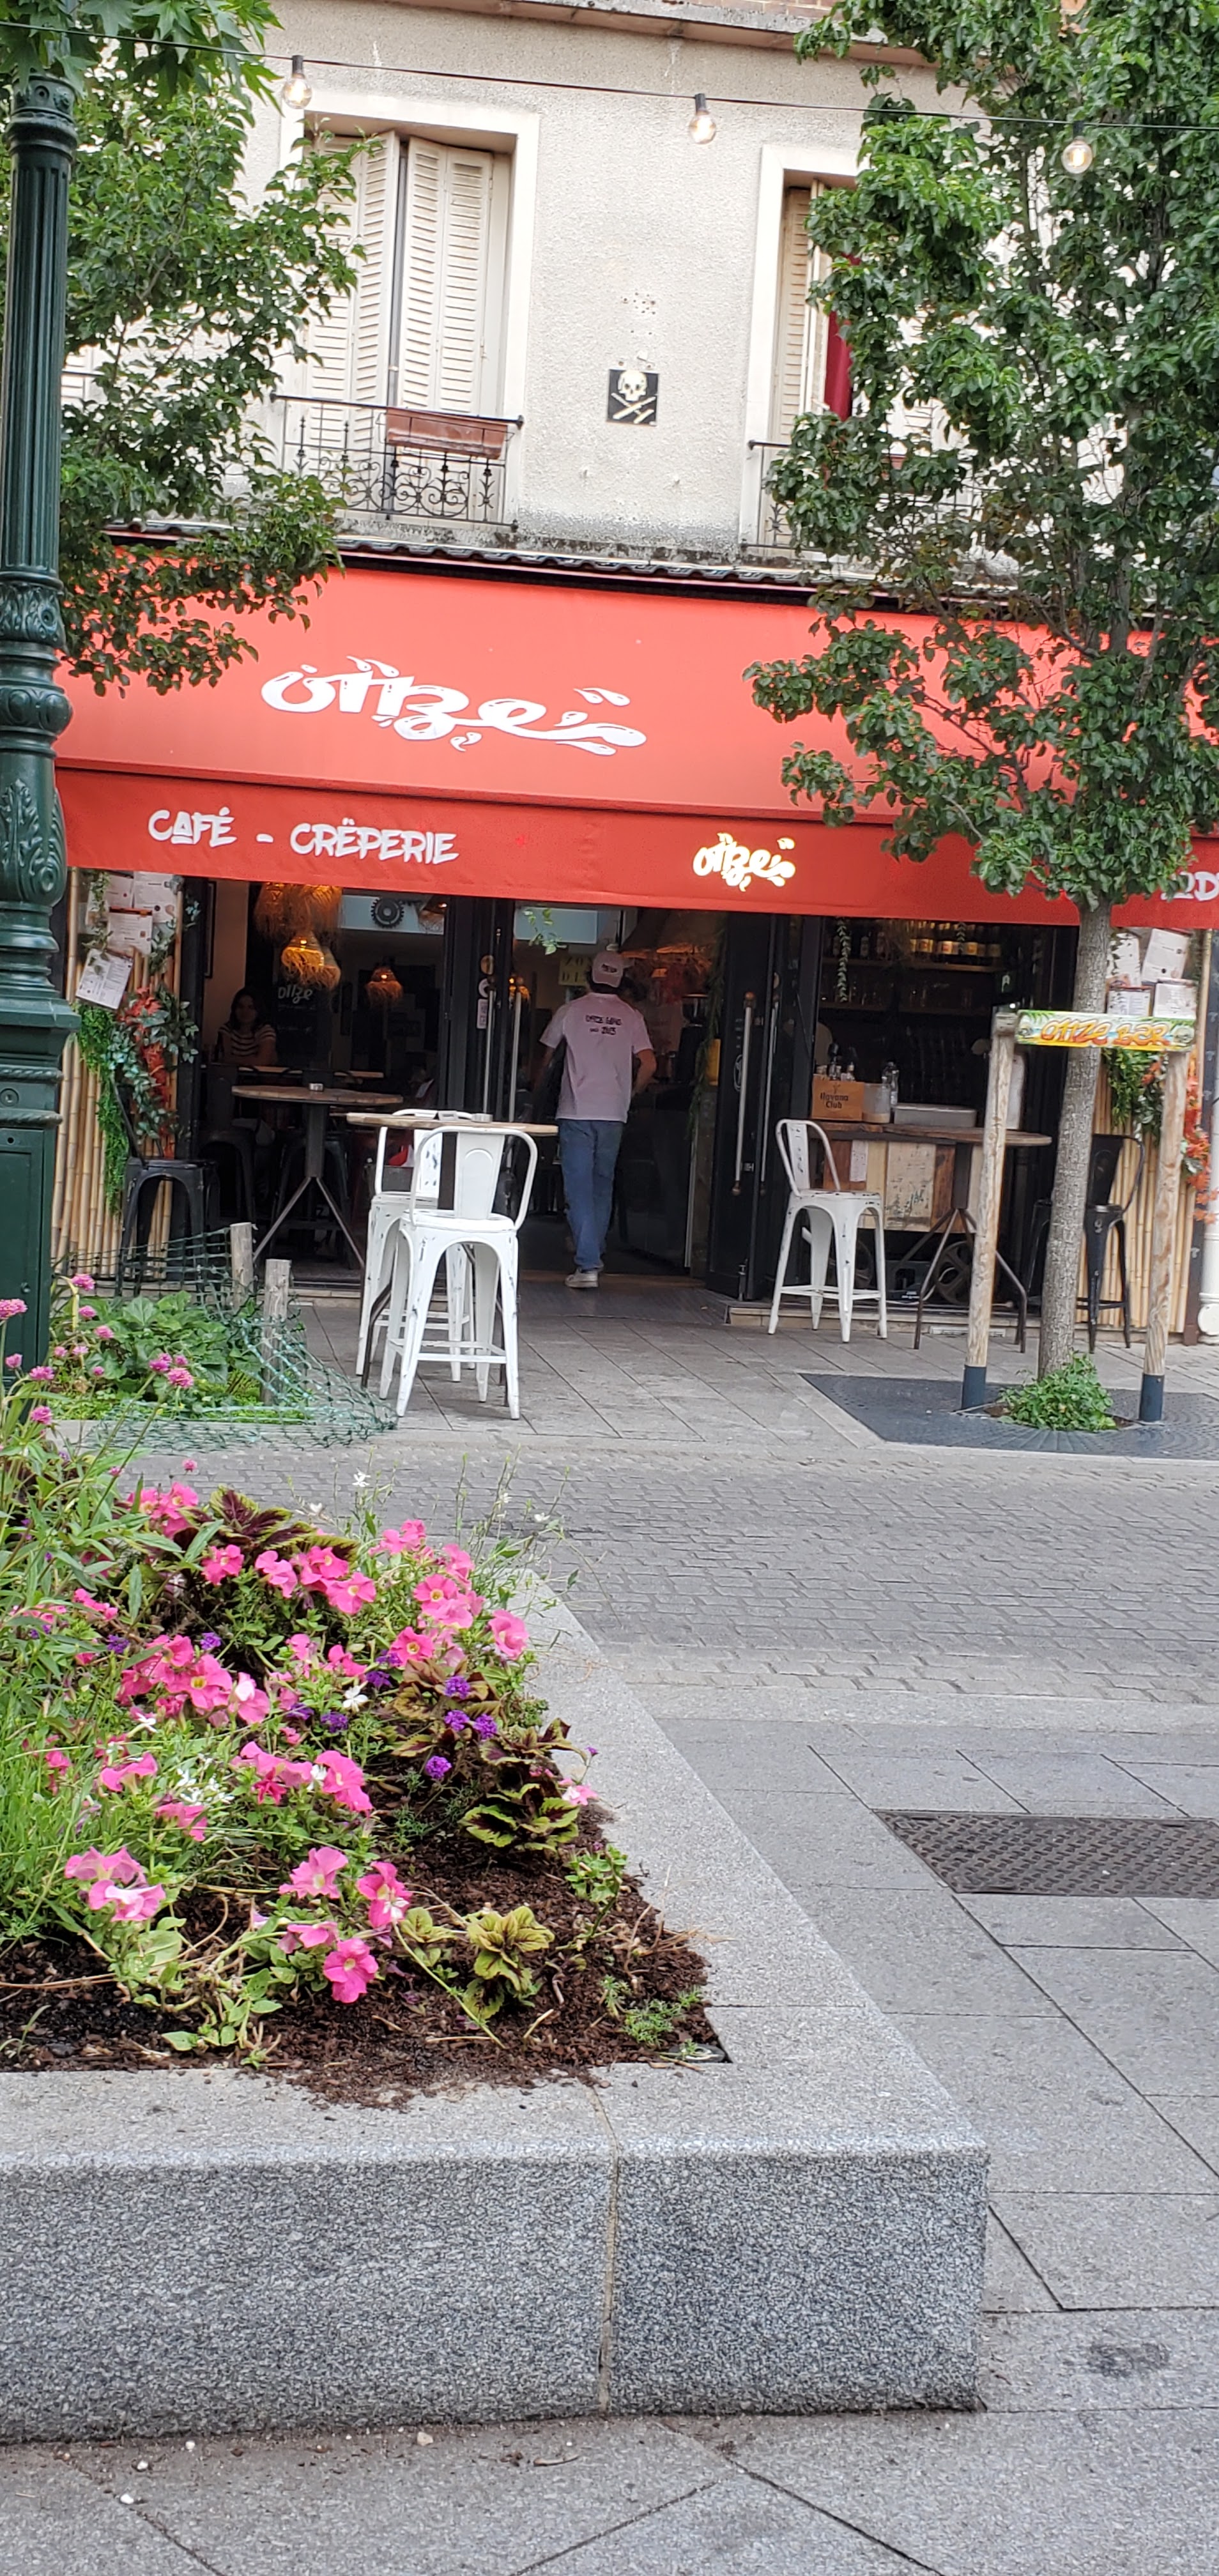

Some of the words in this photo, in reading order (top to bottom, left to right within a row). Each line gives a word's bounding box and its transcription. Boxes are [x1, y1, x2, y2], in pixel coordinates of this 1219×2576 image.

[148, 806, 238, 847] CAFÉ
[820, 1091, 849, 1101] Havana
[825, 1101, 843, 1109] Club
